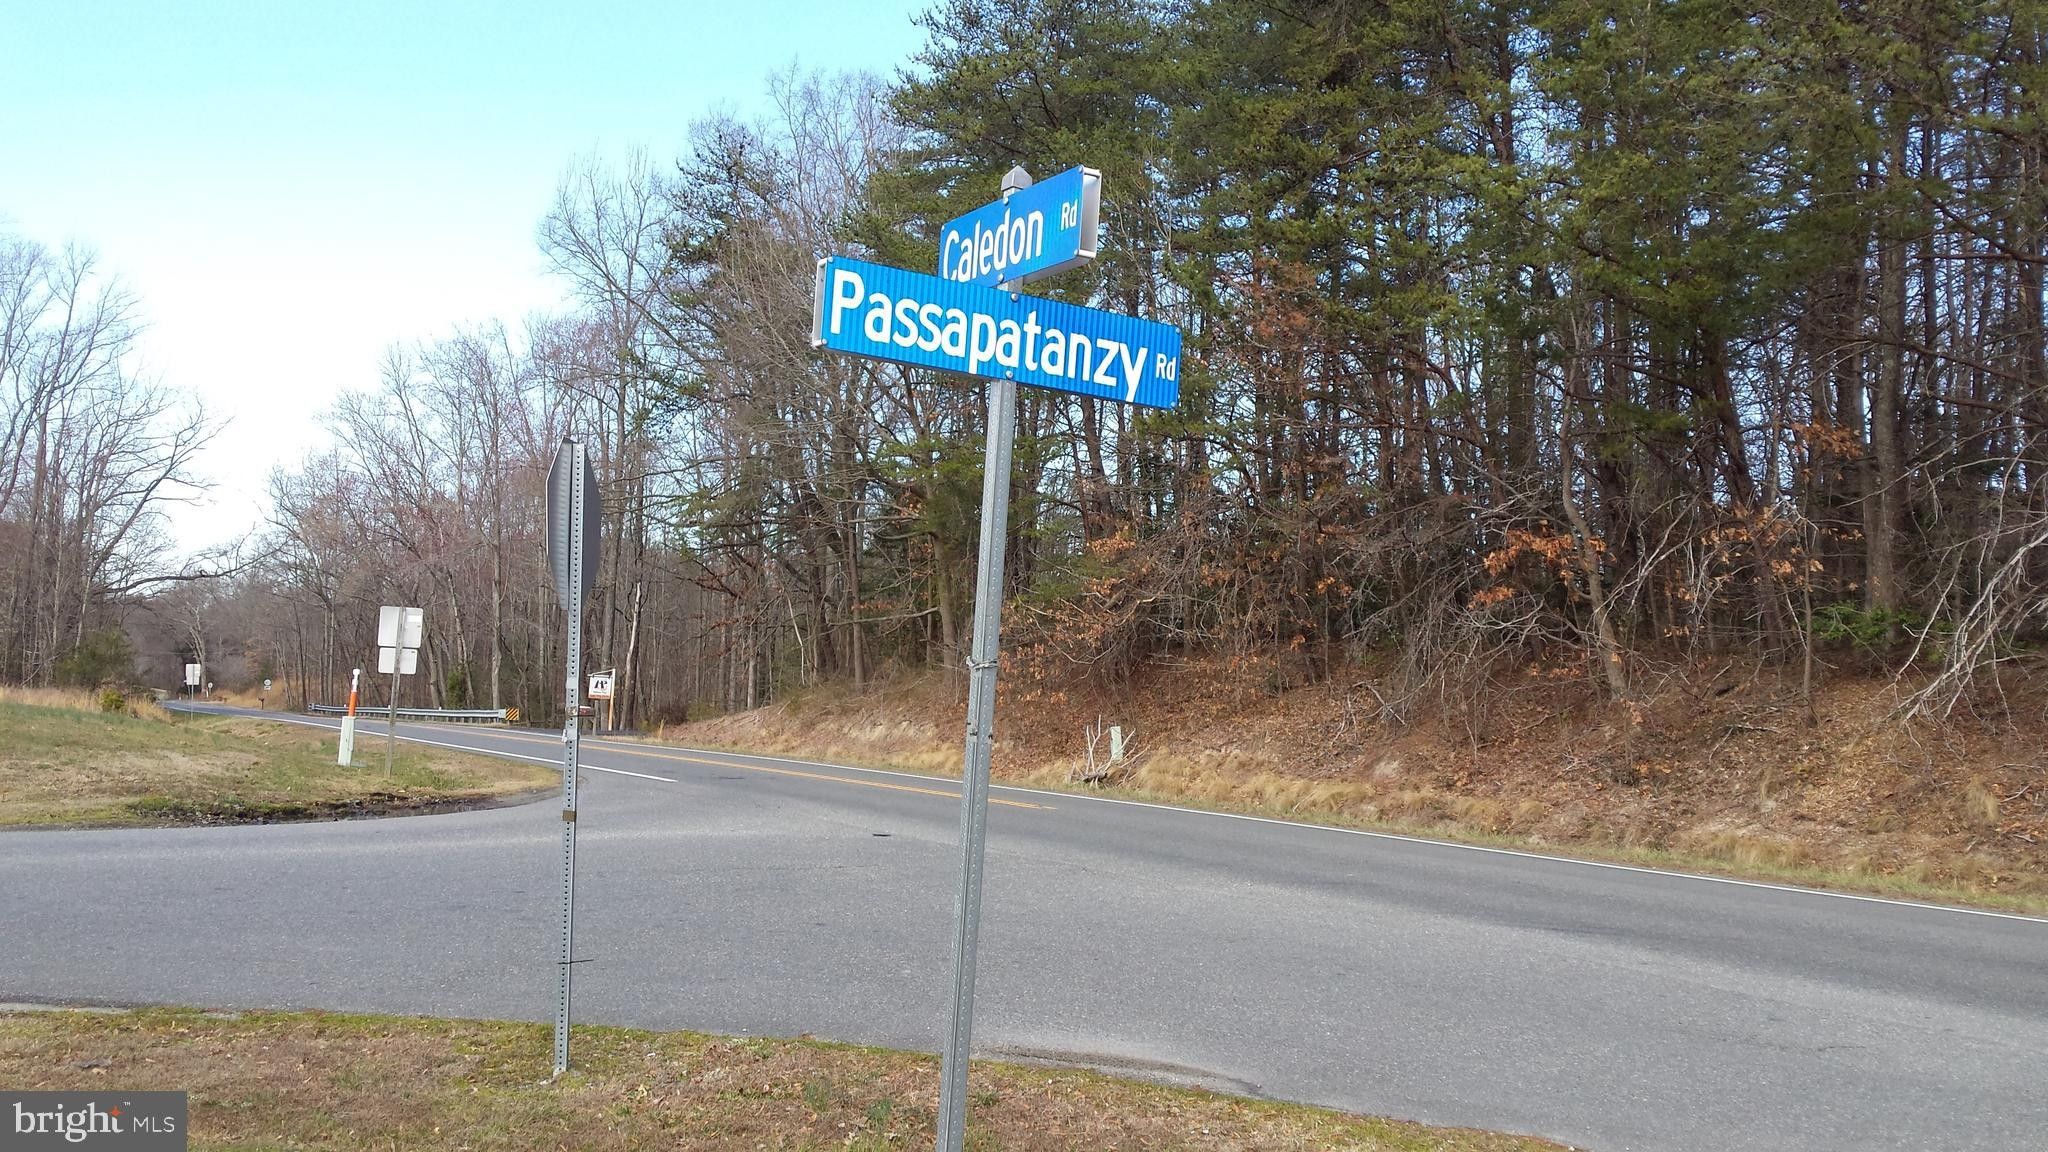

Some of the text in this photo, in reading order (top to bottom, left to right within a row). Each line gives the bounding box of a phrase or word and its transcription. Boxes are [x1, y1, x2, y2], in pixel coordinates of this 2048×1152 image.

[943, 203, 1078, 283] Caledon Rd
[830, 269, 1177, 402] Passapatanzy Rd
